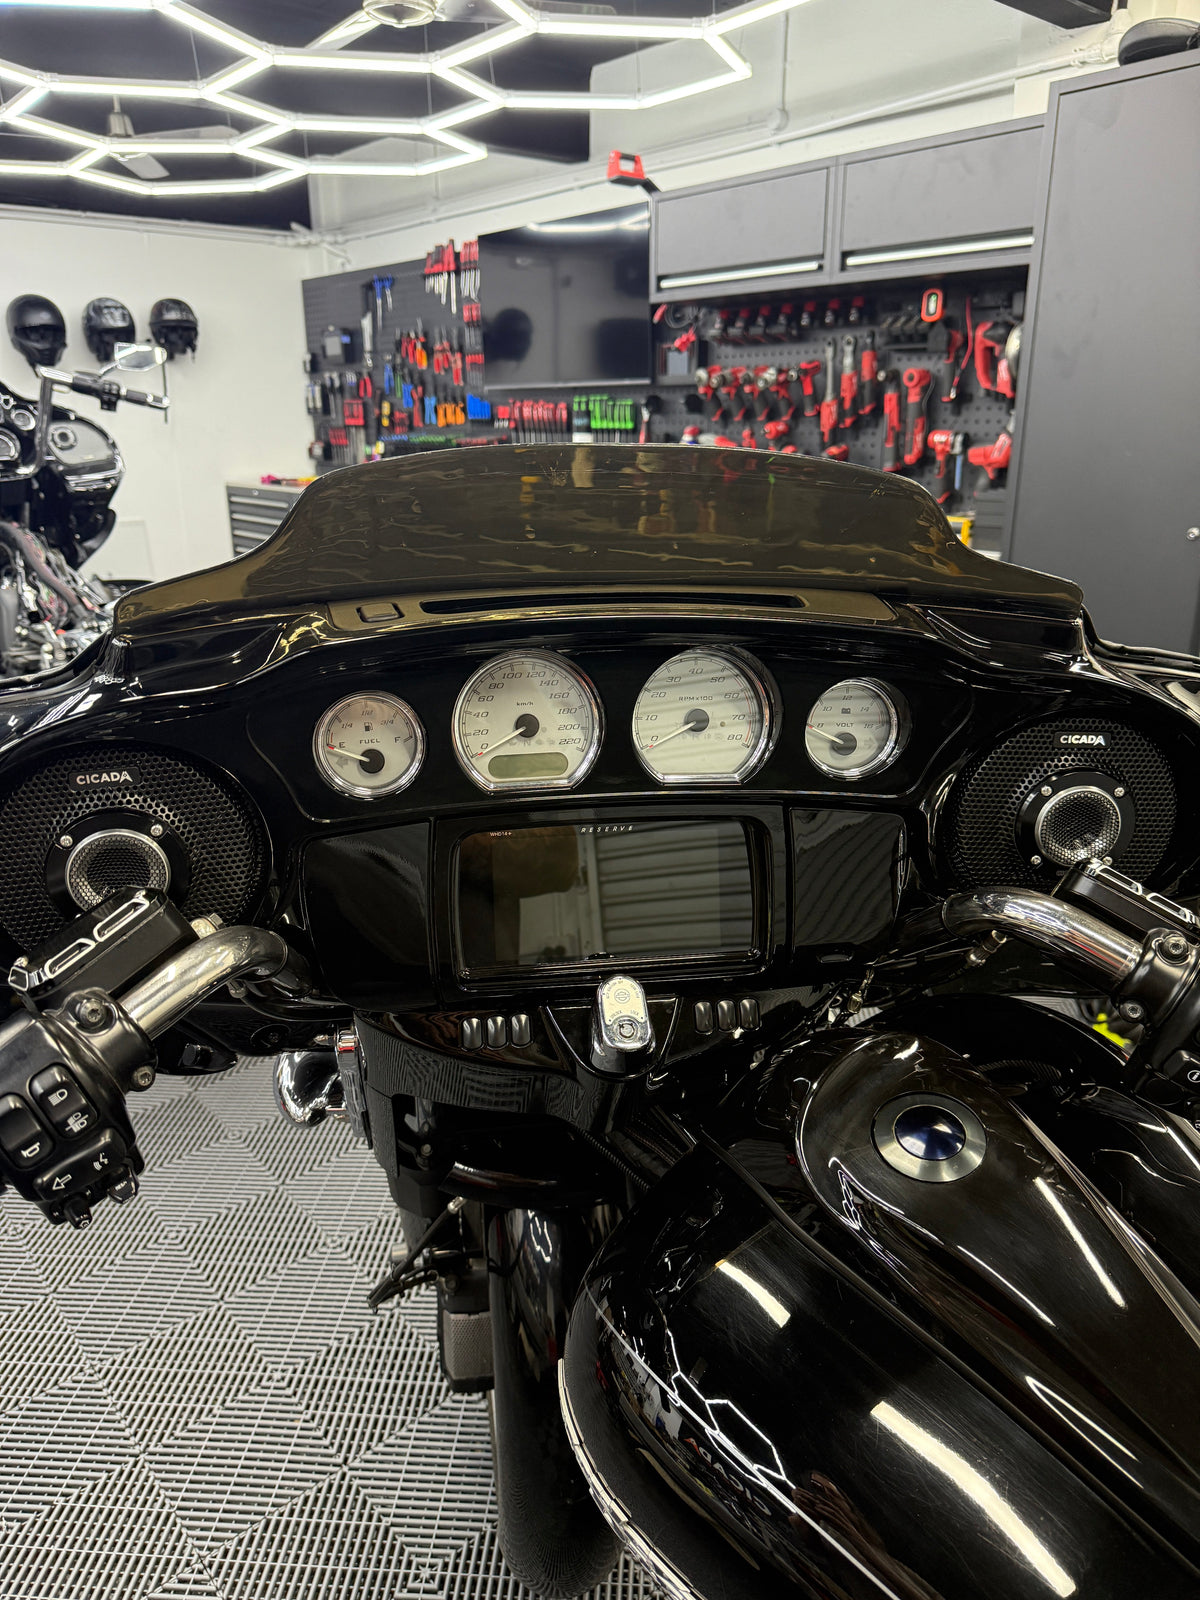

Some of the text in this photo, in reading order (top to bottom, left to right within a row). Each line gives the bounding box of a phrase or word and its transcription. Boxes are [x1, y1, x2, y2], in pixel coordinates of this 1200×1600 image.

[526, 671, 546, 679] 120
[688, 667, 704, 675] 40
[502, 671, 523, 680] 100
[488, 682, 505, 690] 80
[539, 679, 559, 687] 140
[478, 694, 494, 702] 60
[549, 691, 570, 700] 160
[472, 711, 490, 719] 40
[558, 707, 578, 715] 180
[558, 723, 581, 731] 200
[394, 736, 401, 744] F
[727, 733, 743, 741] 80
[1060, 734, 1106, 746] CICADA
[338, 741, 346, 749] E
[558, 738, 582, 746] 220
[76, 770, 134, 785] CICADA
[580, 825, 634, 833] RESERVE
